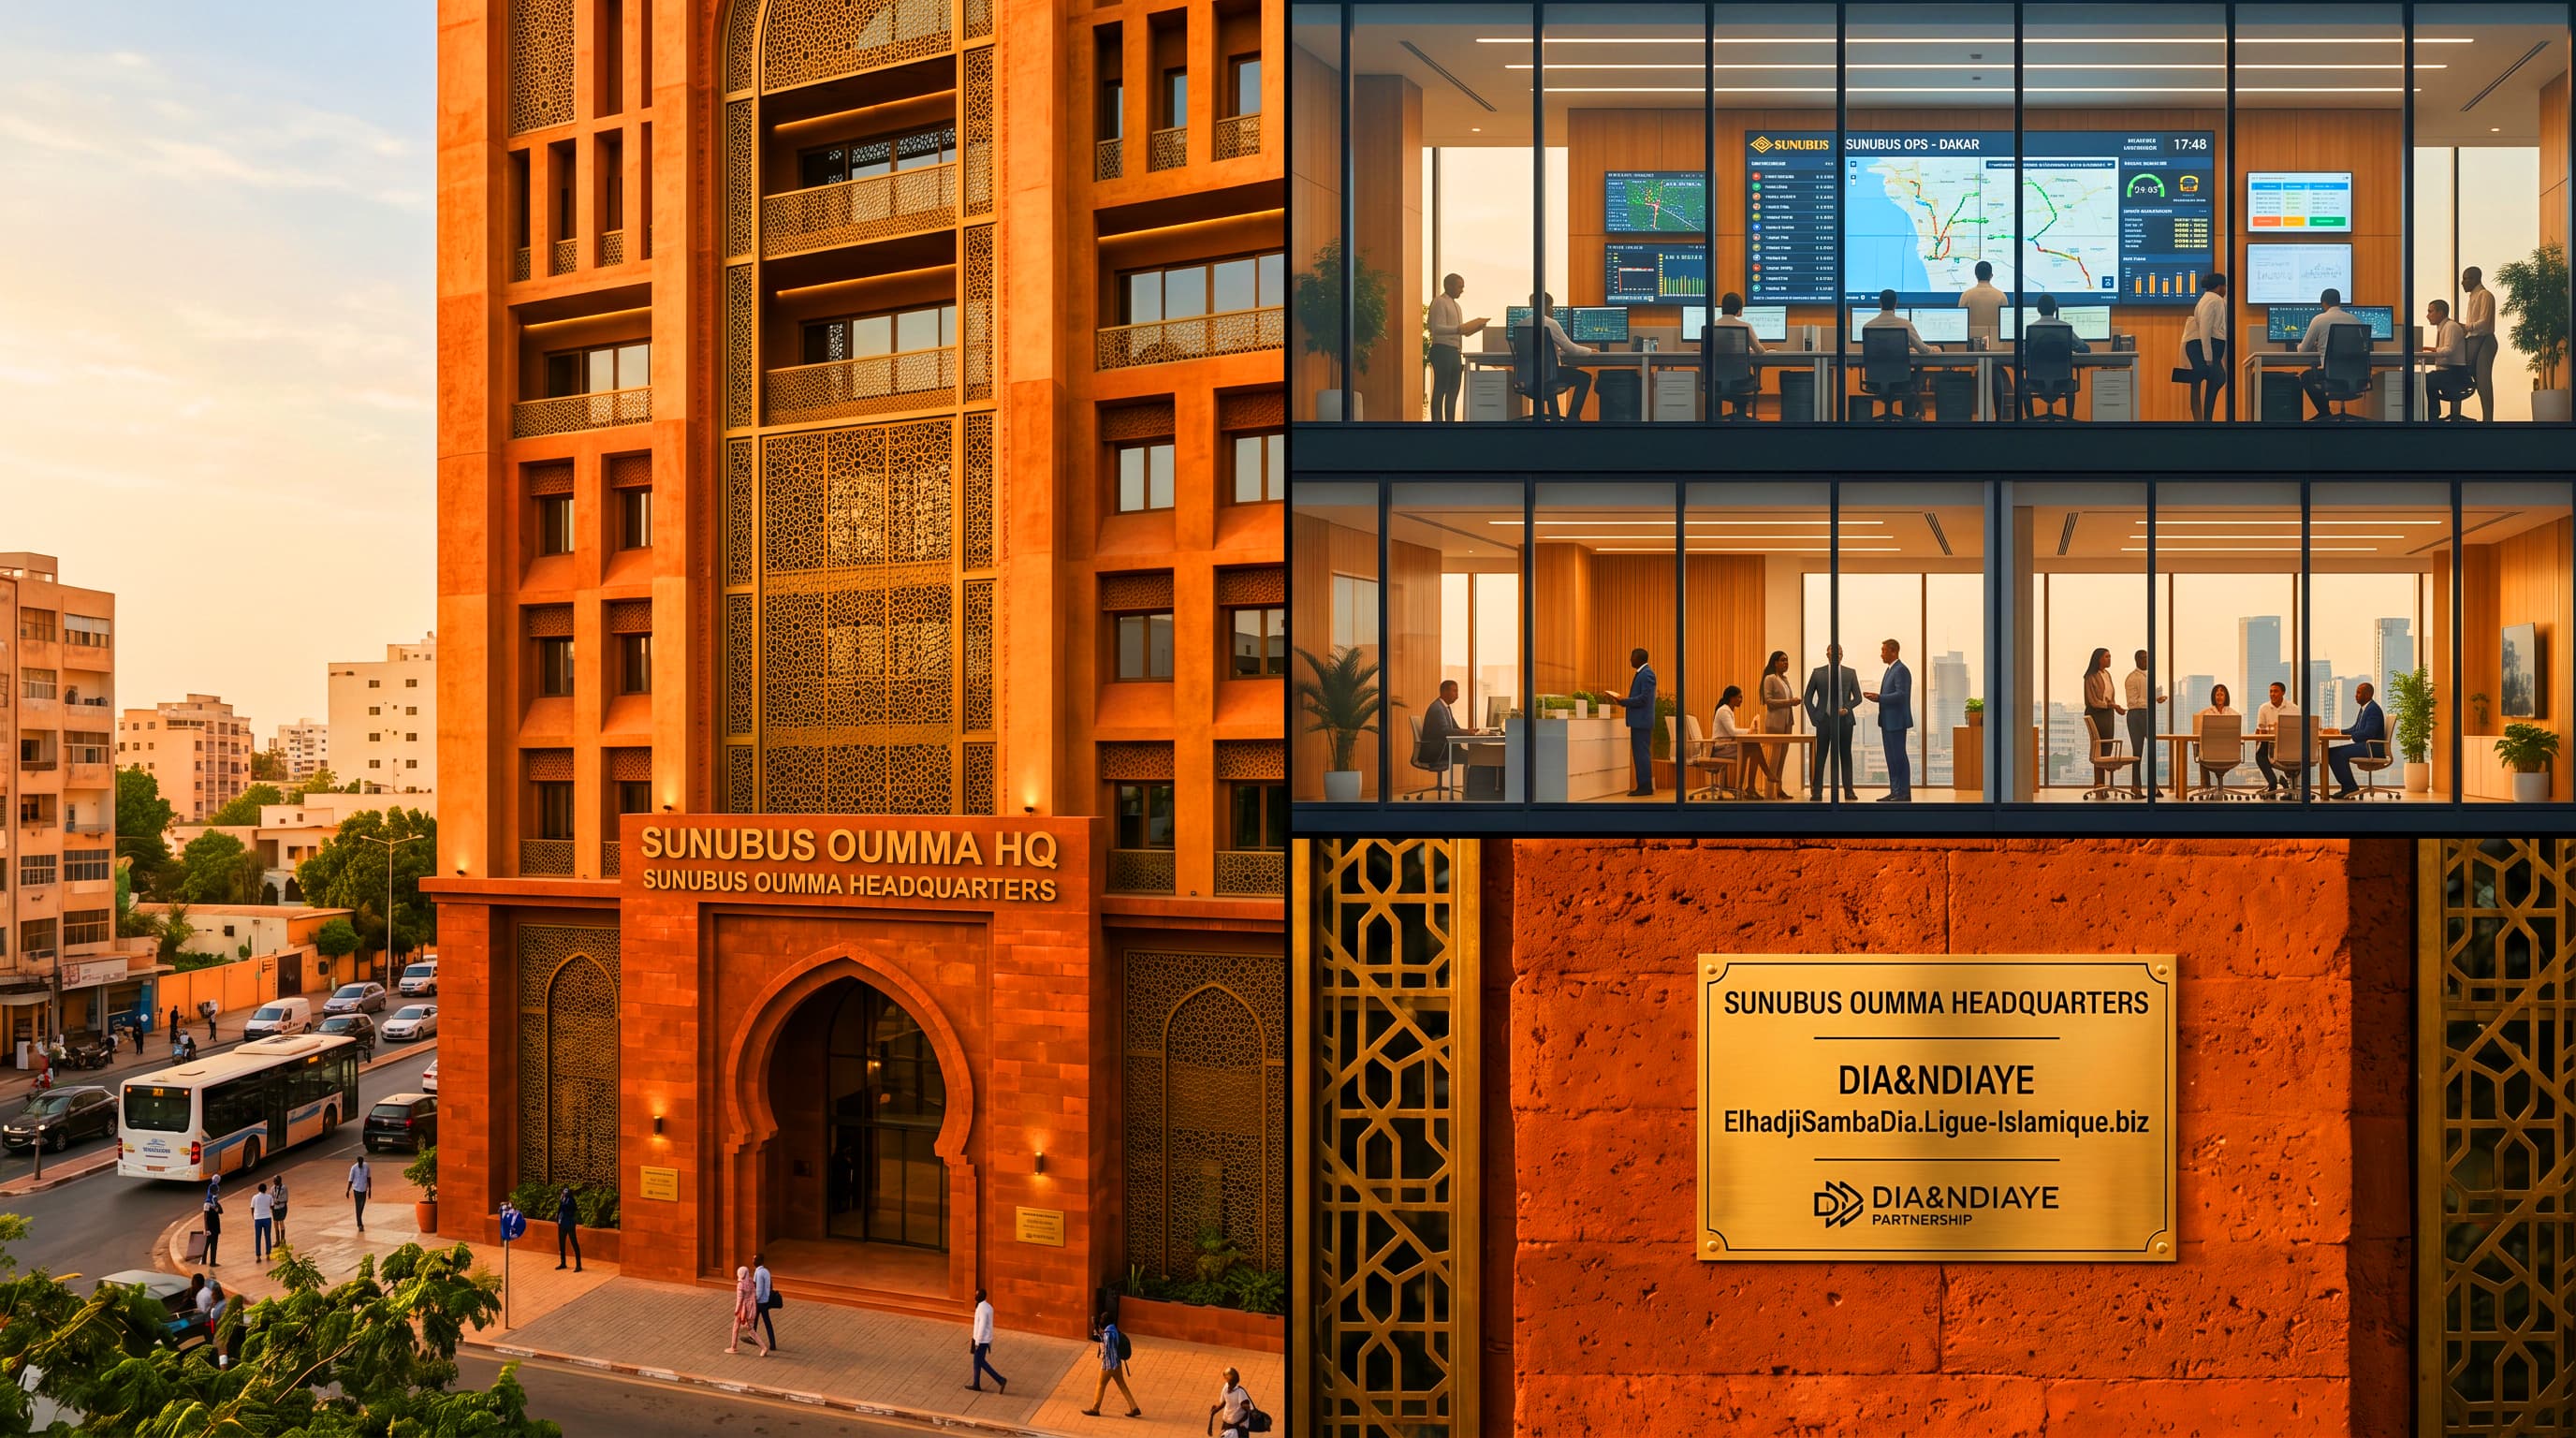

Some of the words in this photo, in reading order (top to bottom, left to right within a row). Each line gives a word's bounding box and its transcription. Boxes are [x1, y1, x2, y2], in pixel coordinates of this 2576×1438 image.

[1774, 139, 1829, 151] SUNUBUS
[1845, 139, 1901, 151] SUNUBUS
[1904, 139, 1928, 151] OPS
[1939, 139, 1980, 150] DAKAR
[2174, 139, 2207, 150] 17:48
[640, 826, 816, 862] SUNUBUS
[827, 829, 983, 866] OUMMA
[995, 830, 1058, 870] HQ
[643, 868, 748, 892] SUNUBUS
[754, 872, 843, 895] OUMMA
[850, 873, 1057, 902] HEADQUARTERS
[1724, 990, 1842, 1015] SUNUBUS
[1850, 990, 1945, 1015] OUMMA
[1952, 990, 2150, 1017] HEADQUARTERS
[1839, 1064, 2035, 1095] DIA&NDIAYE
[1724, 1109, 2150, 1139] ElhadjiSambaDia.Ligue-Islamique.biz
[1873, 1185, 2059, 1210] DIA&NDIAYE
[1872, 1214, 1972, 1225] PARTNERSHIP
